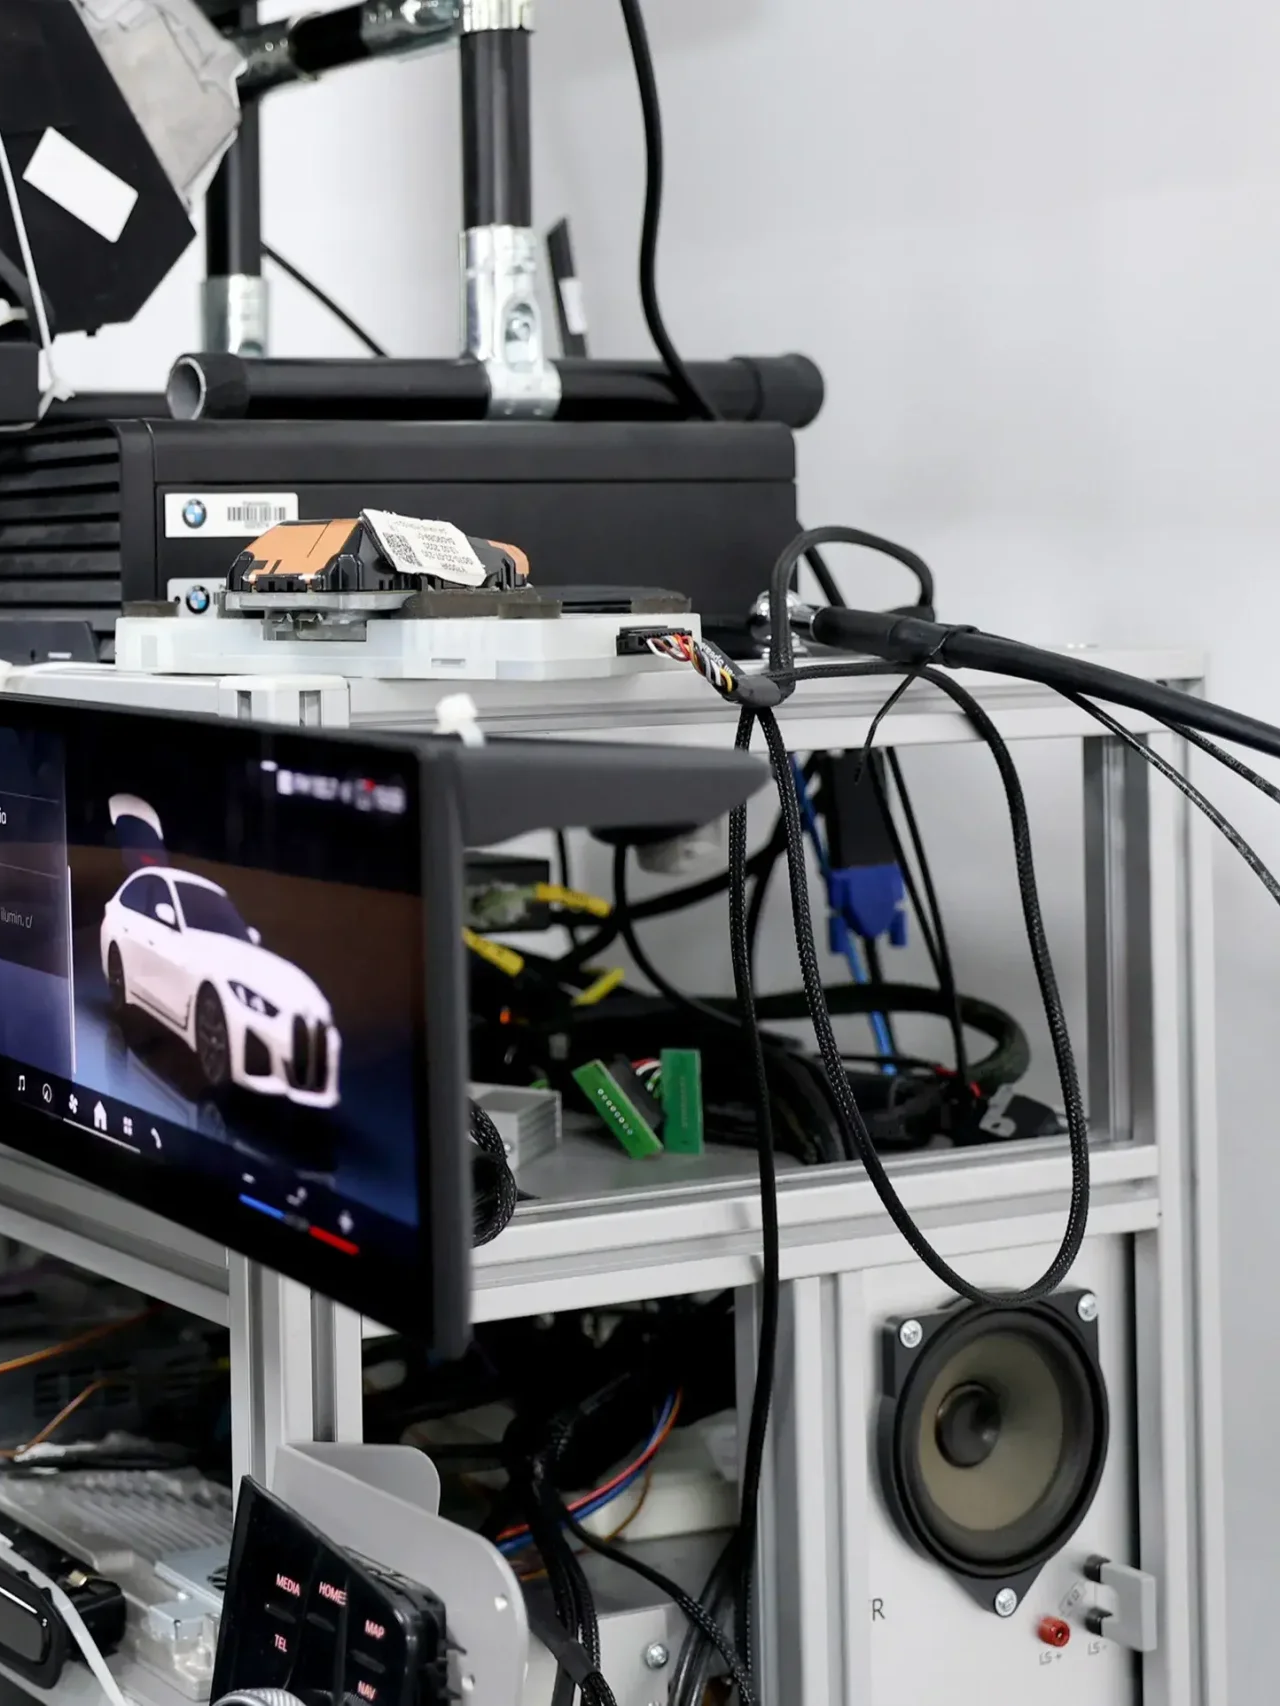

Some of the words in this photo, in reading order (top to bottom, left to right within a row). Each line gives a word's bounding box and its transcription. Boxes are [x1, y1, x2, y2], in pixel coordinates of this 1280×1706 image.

[276, 1573, 300, 1597] MEDIA
[318, 1581, 347, 1606] HOME
[872, 1598, 885, 1620] R
[365, 1618, 385, 1639] MAP
[274, 1633, 288, 1653] TEL
[357, 1680, 377, 1701] NAV
